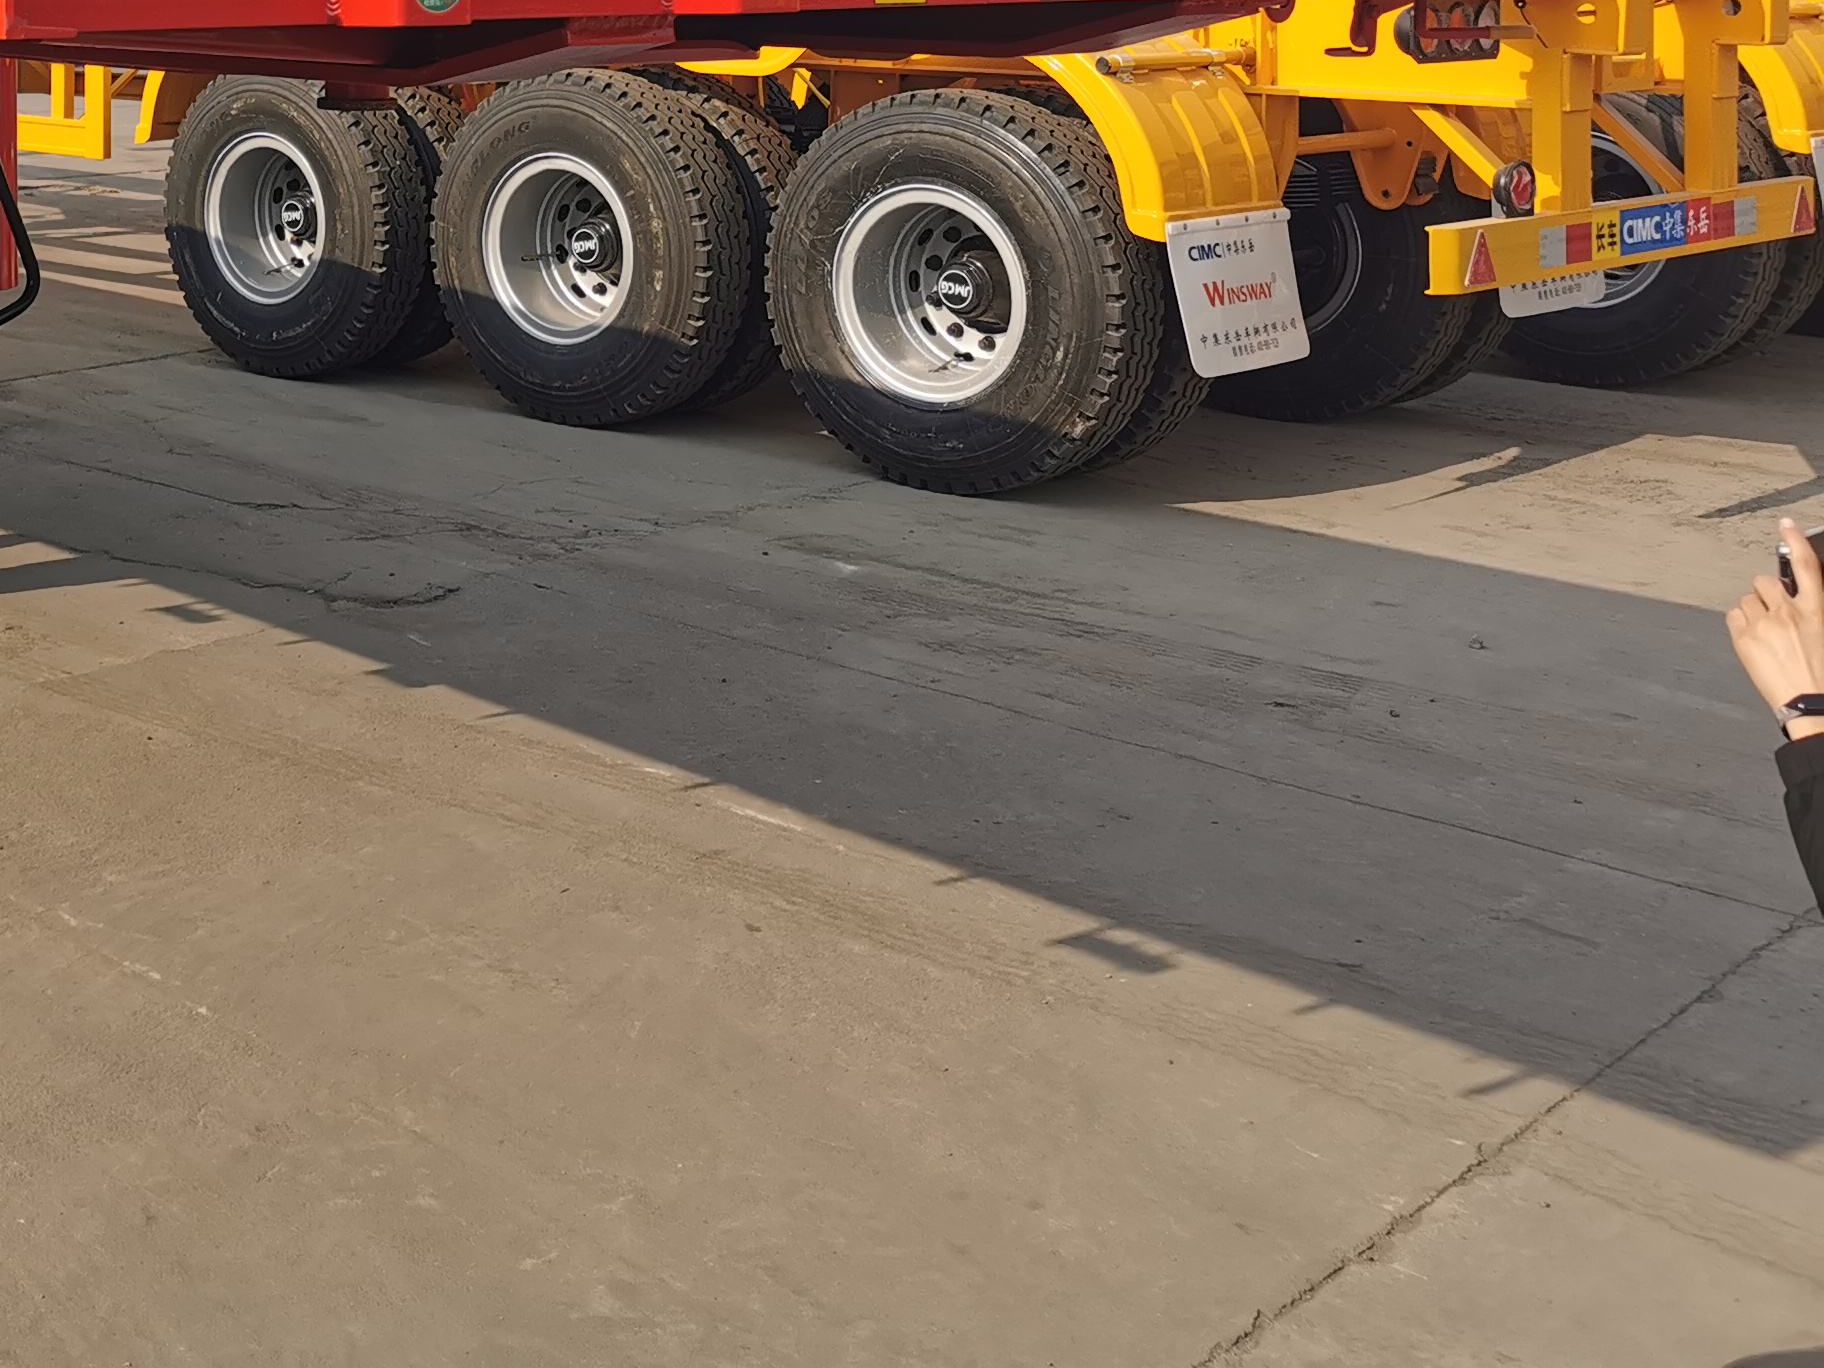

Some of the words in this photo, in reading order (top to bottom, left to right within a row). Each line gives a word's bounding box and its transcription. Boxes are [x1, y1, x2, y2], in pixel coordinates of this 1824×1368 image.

[1622, 215, 1662, 244] CIMC
[574, 238, 597, 253] JMCG
[1188, 243, 1222, 262] CIMC
[940, 280, 971, 298] JMCG
